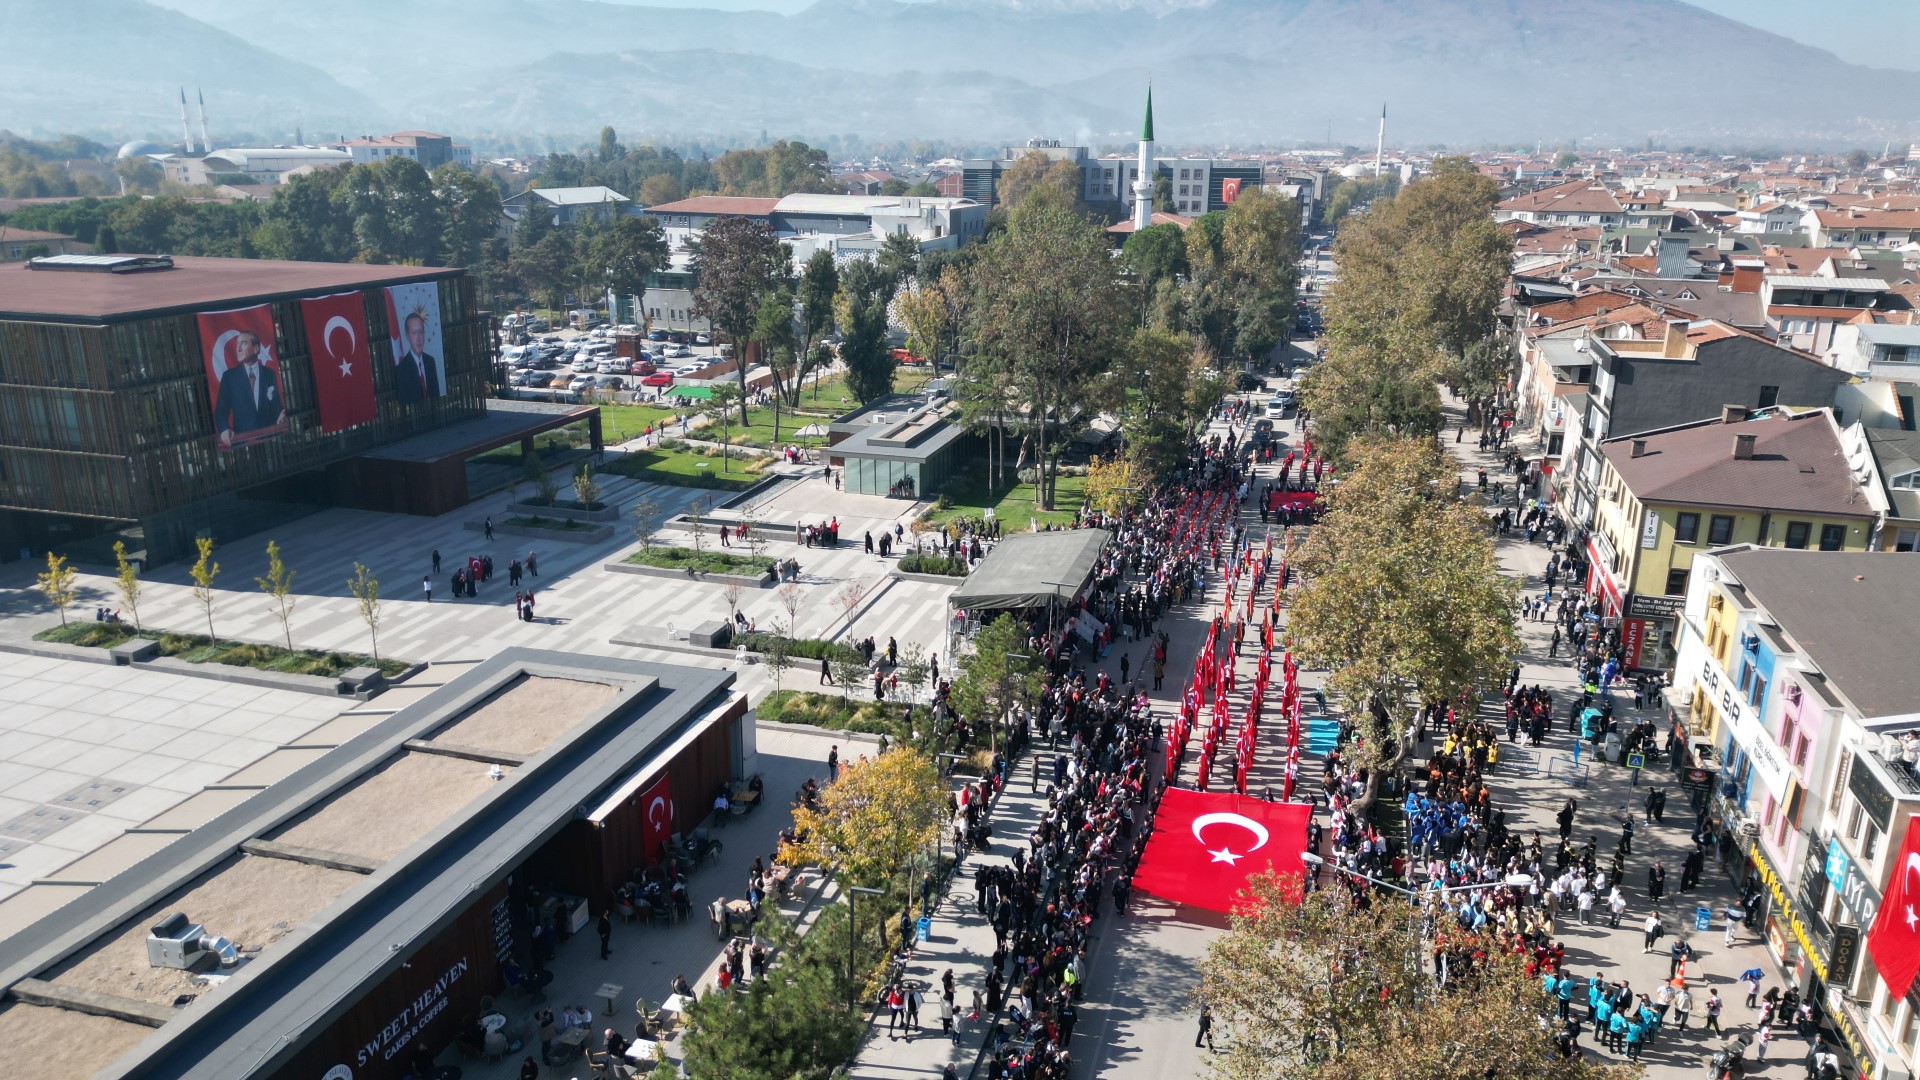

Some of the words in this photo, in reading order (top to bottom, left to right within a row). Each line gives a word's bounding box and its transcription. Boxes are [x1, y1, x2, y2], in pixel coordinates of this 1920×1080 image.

[1625, 622, 1637, 665] ECZANE
[1767, 870, 1784, 907] Pide
[1783, 898, 1792, 920] &
[357, 1008, 410, 1068] SWEET
[412, 956, 468, 1018] HEAVEN
[384, 1031, 412, 1060] CAKES
[411, 1026, 419, 1035] &
[419, 996, 449, 1029] COFFEE
